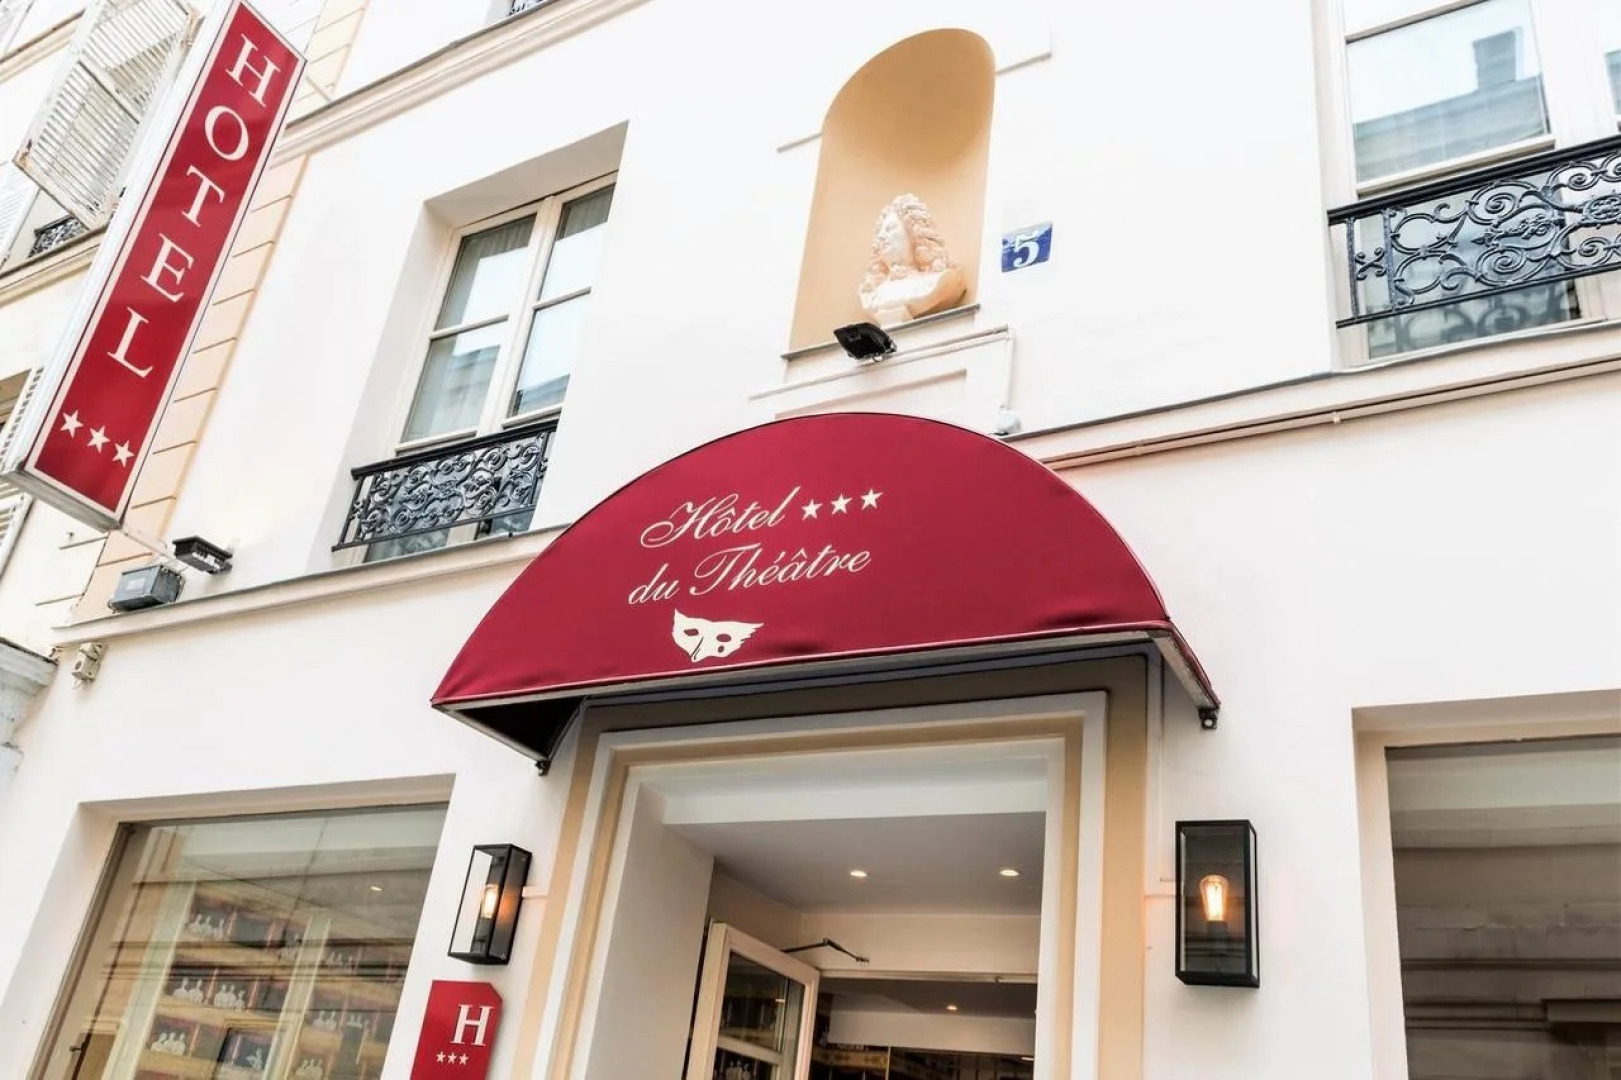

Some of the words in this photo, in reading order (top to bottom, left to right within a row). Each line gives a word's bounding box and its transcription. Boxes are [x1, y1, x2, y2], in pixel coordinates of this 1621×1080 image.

[107, 33, 280, 378] HOTEL
[1013, 231, 1039, 268] 5
[640, 486, 800, 548] Hôtel
[628, 563, 679, 605] du
[689, 542, 871, 596] Théâtre
[449, 1003, 494, 1046] H
